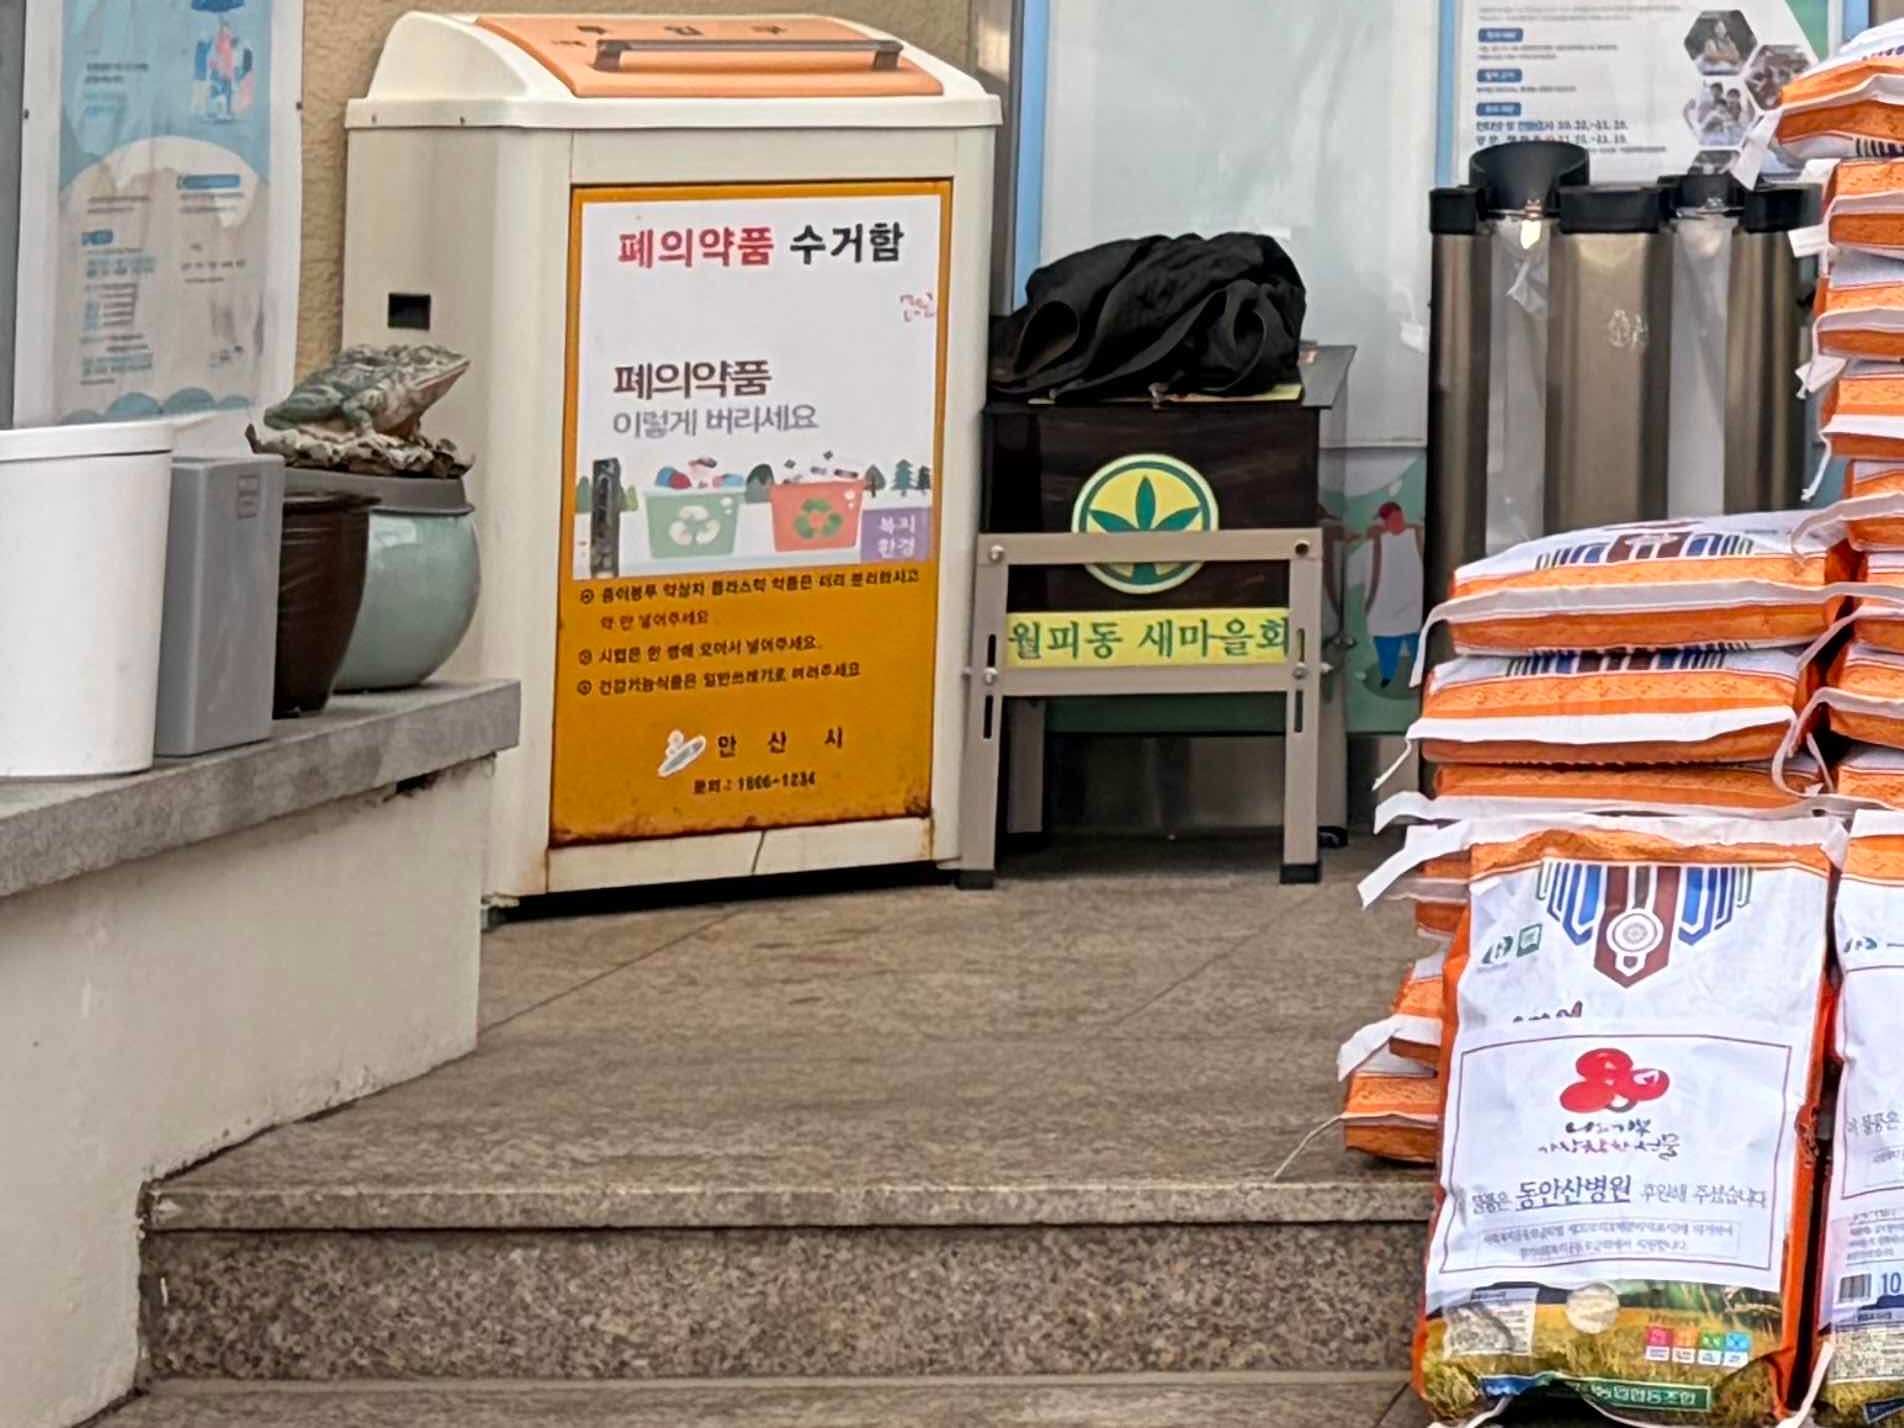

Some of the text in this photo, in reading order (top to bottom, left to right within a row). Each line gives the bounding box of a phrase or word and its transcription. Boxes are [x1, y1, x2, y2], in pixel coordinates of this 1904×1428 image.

[618, 221, 904, 269] 폐의약품 수거함
[613, 360, 772, 400] 폐의약품
[613, 404, 820, 439] 이렇게 버리세요
[1008, 616, 1290, 660] 월피동 새마을회
[1516, 1174, 1632, 1212] 동안산병원
[1880, 1272, 1902, 1296] 10
